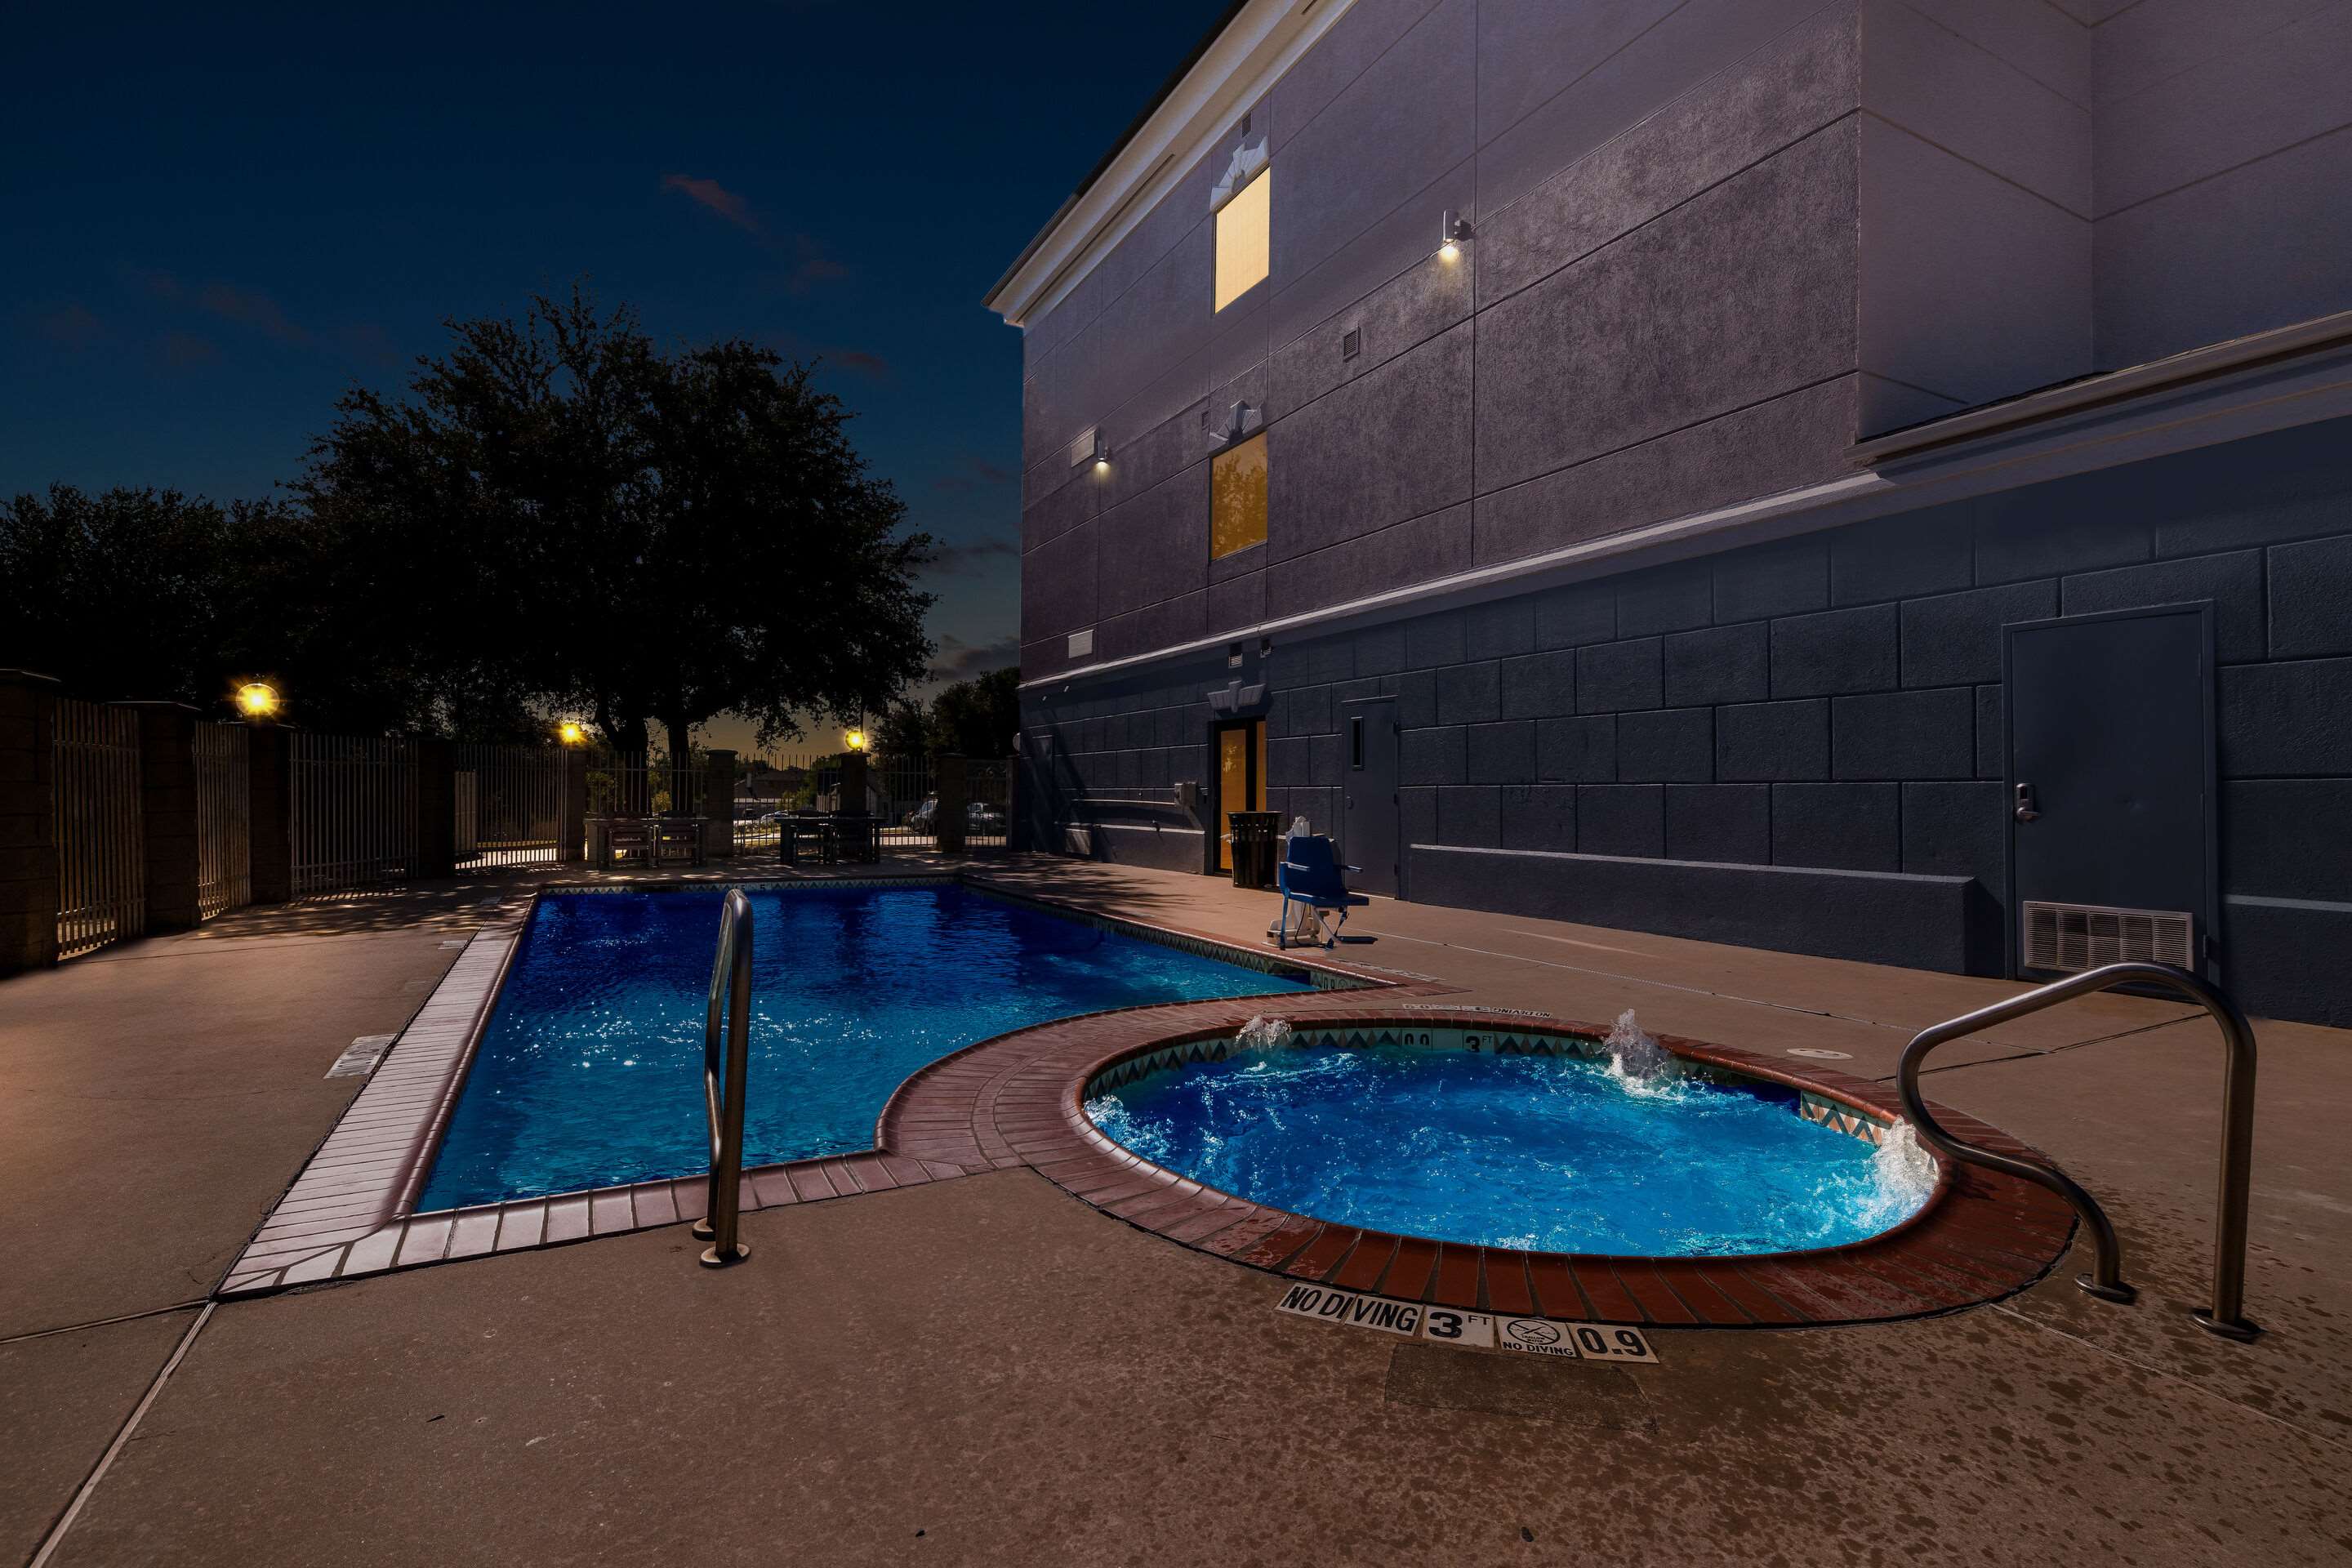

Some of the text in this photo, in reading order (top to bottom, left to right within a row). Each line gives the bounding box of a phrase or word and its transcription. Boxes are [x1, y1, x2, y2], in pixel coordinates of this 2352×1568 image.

[1482, 1036, 1493, 1044] FT
[1281, 1285, 1419, 1332] NO DIVING
[1428, 1312, 1491, 1339] 3 FT
[1503, 1341, 1574, 1356] NO DIVING
[1577, 1327, 1647, 1356] 0.9
